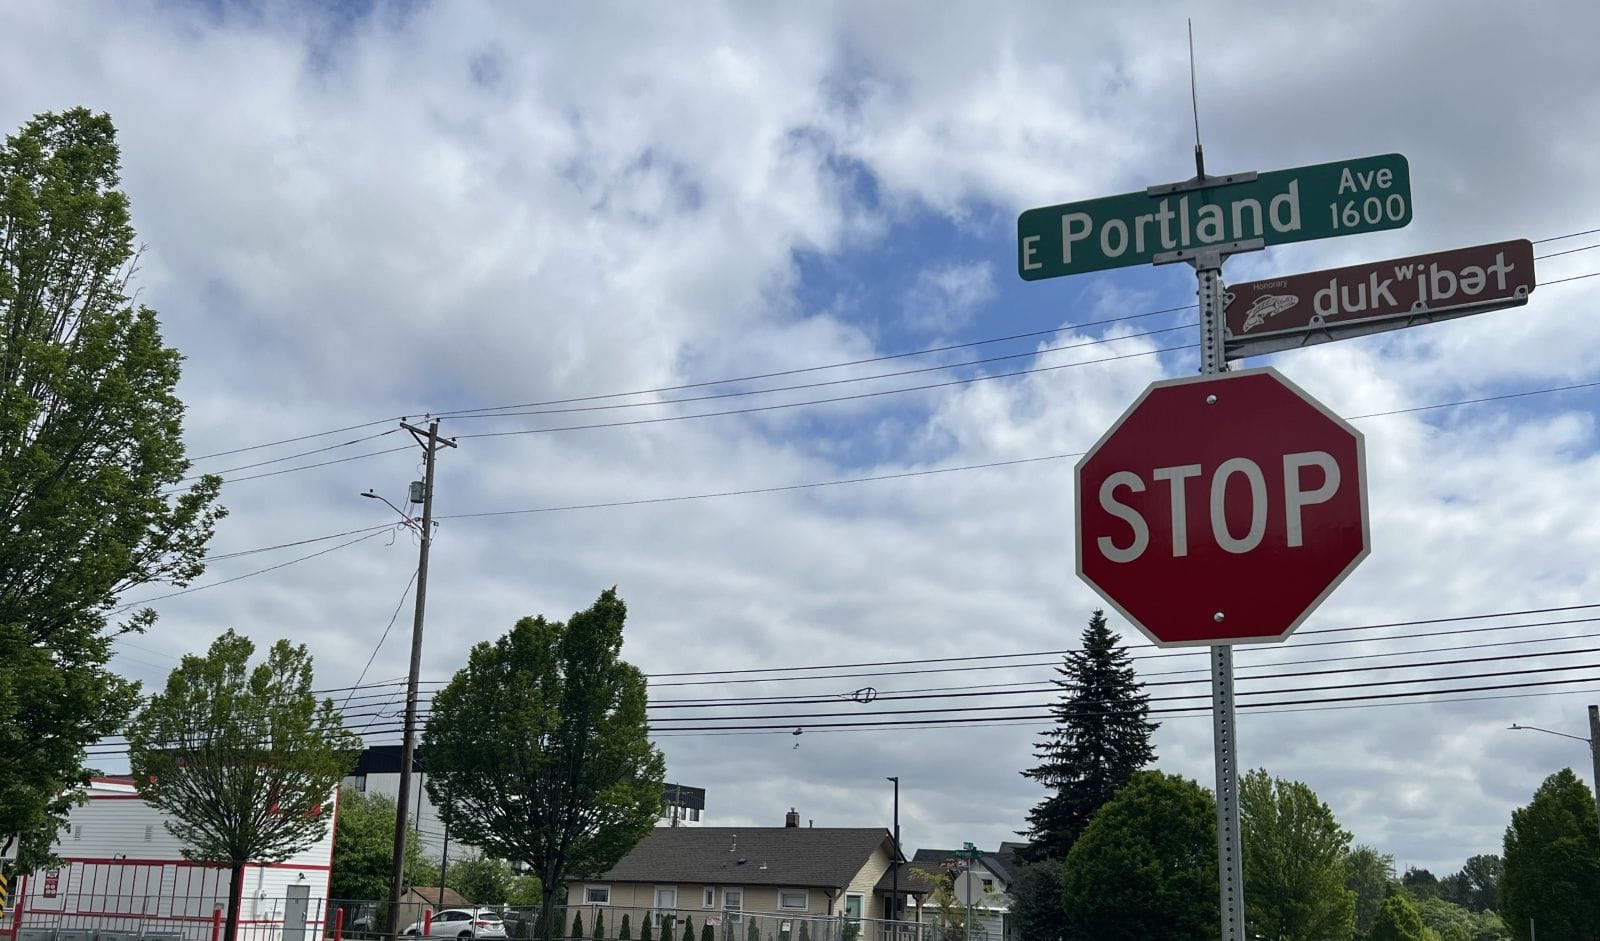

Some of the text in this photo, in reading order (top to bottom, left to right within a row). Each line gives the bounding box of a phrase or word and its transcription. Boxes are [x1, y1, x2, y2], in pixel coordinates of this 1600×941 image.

[1023, 167, 1394, 271] E Portland Ave
[1329, 193, 1406, 230] 1600
[1253, 279, 1288, 292] Honorary
[1097, 450, 1341, 563] STOP
